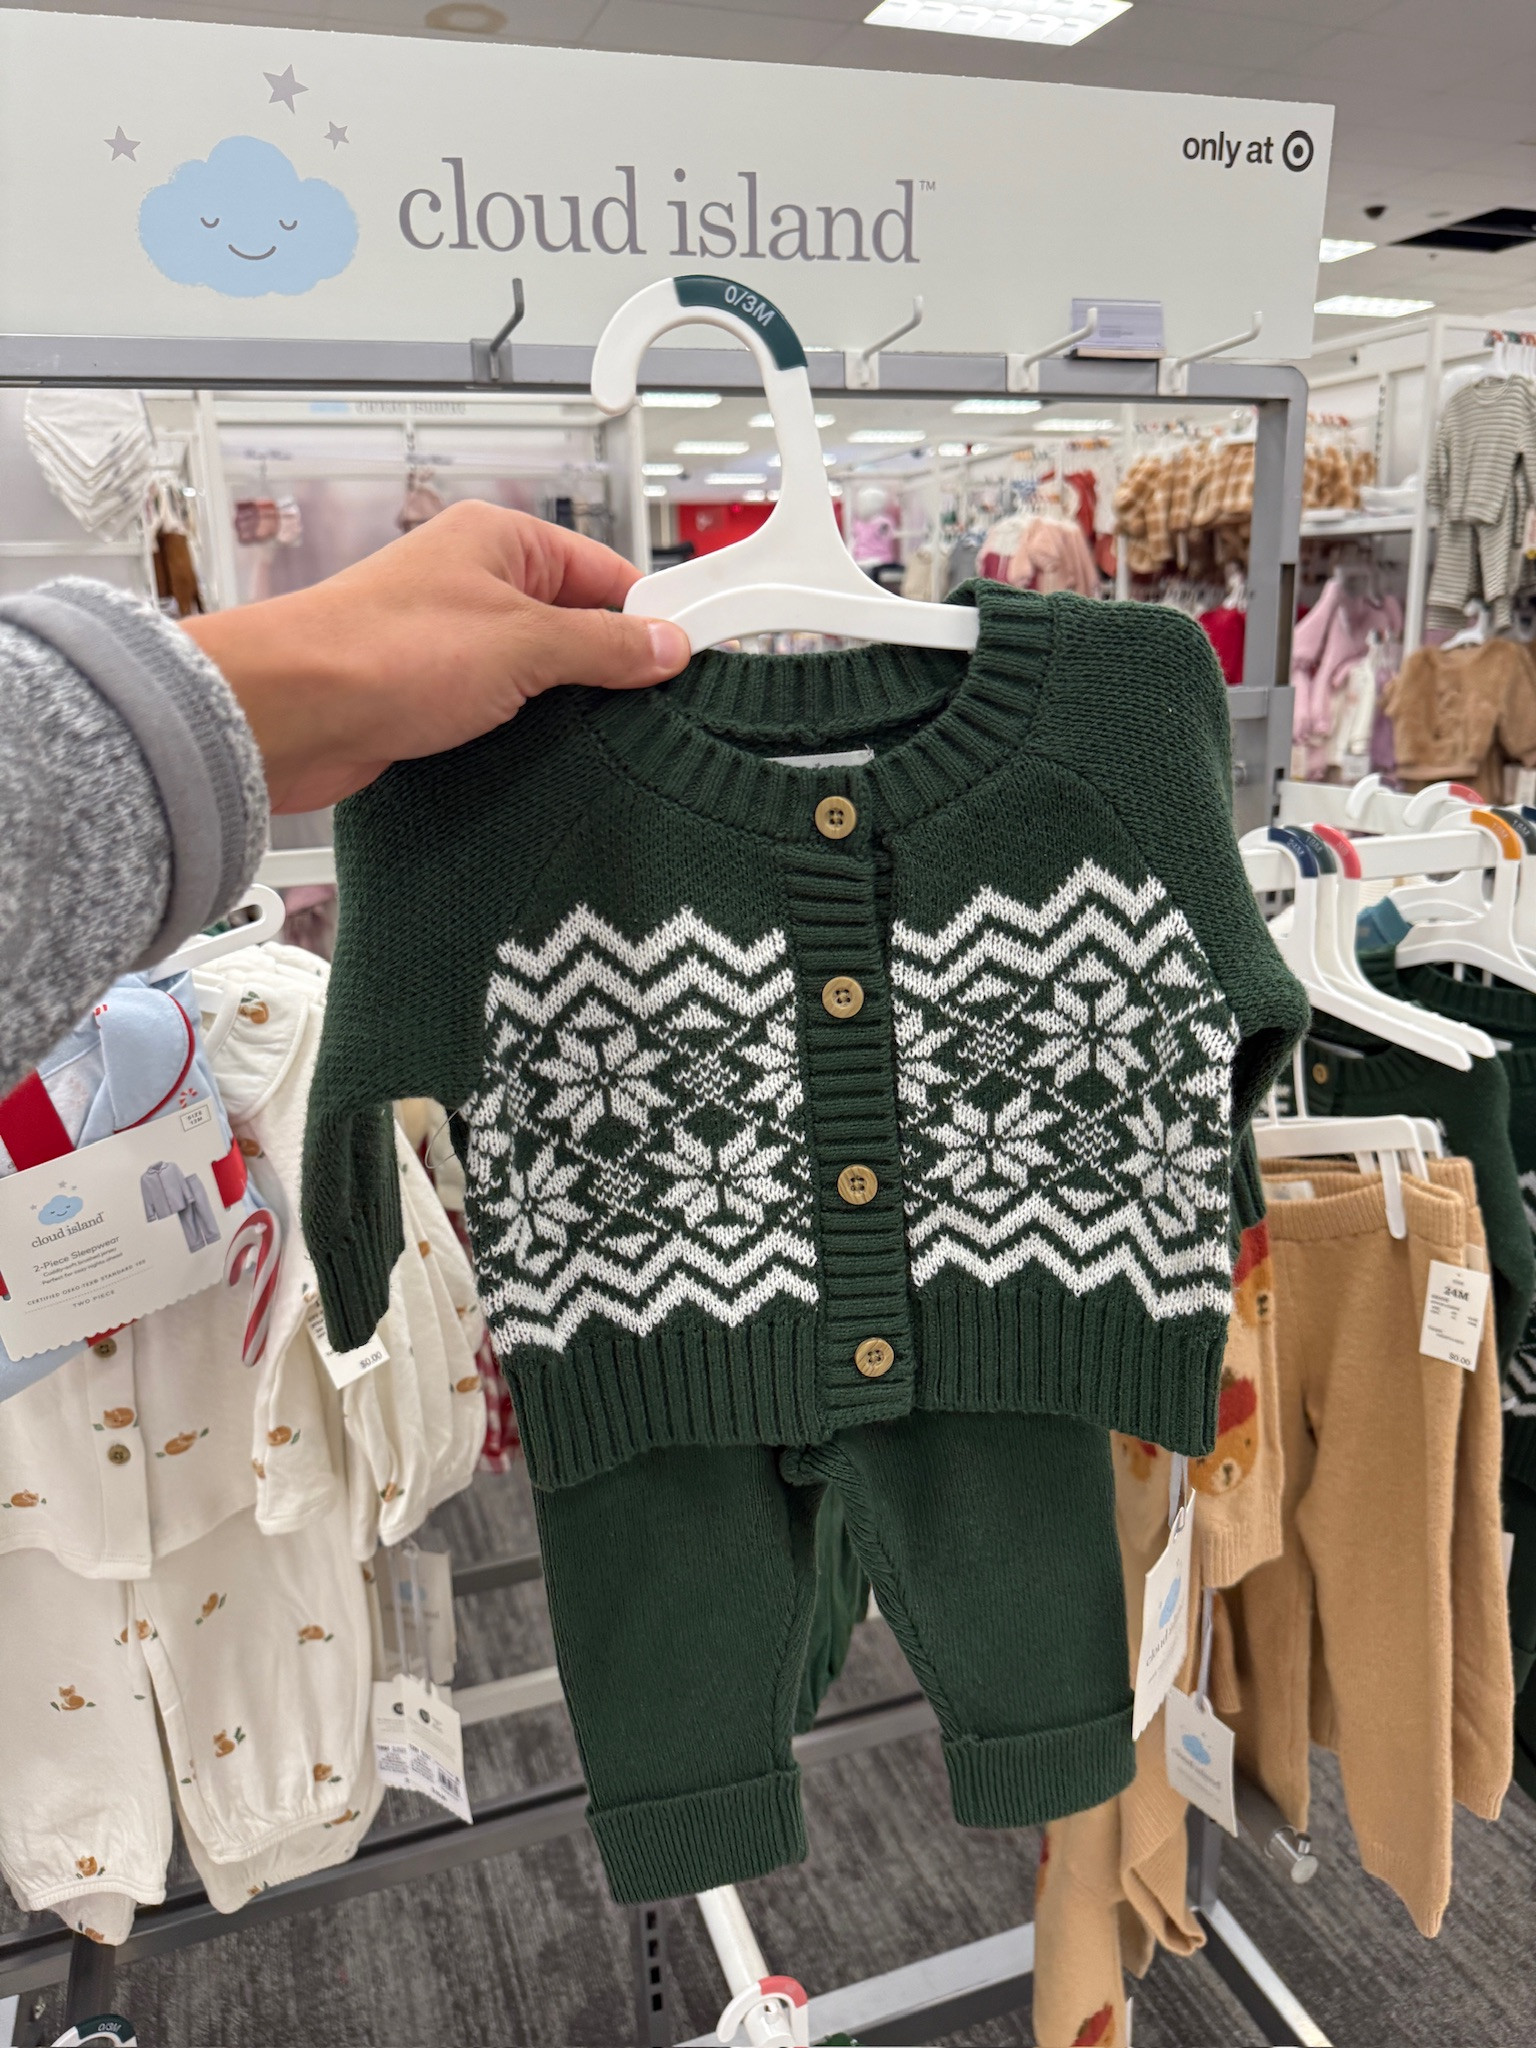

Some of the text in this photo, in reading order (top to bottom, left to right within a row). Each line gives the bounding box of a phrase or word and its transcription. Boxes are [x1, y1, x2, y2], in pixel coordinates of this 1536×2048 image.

[1182, 131, 1274, 168] only at
[399, 157, 647, 255] cloud
[666, 167, 920, 264] island
[724, 285, 776, 327] 0/3M
[31, 1213, 104, 1248] cloud island
[33, 1236, 120, 1273] 2-Piece Sleepwear
[27, 1292, 60, 1306] CERTIFIED
[100, 1264, 133, 1281] STANDARD
[73, 1290, 115, 1308] TWO PIECE
[1443, 1286, 1469, 1301] 24M
[360, 1351, 383, 1369] $0.00
